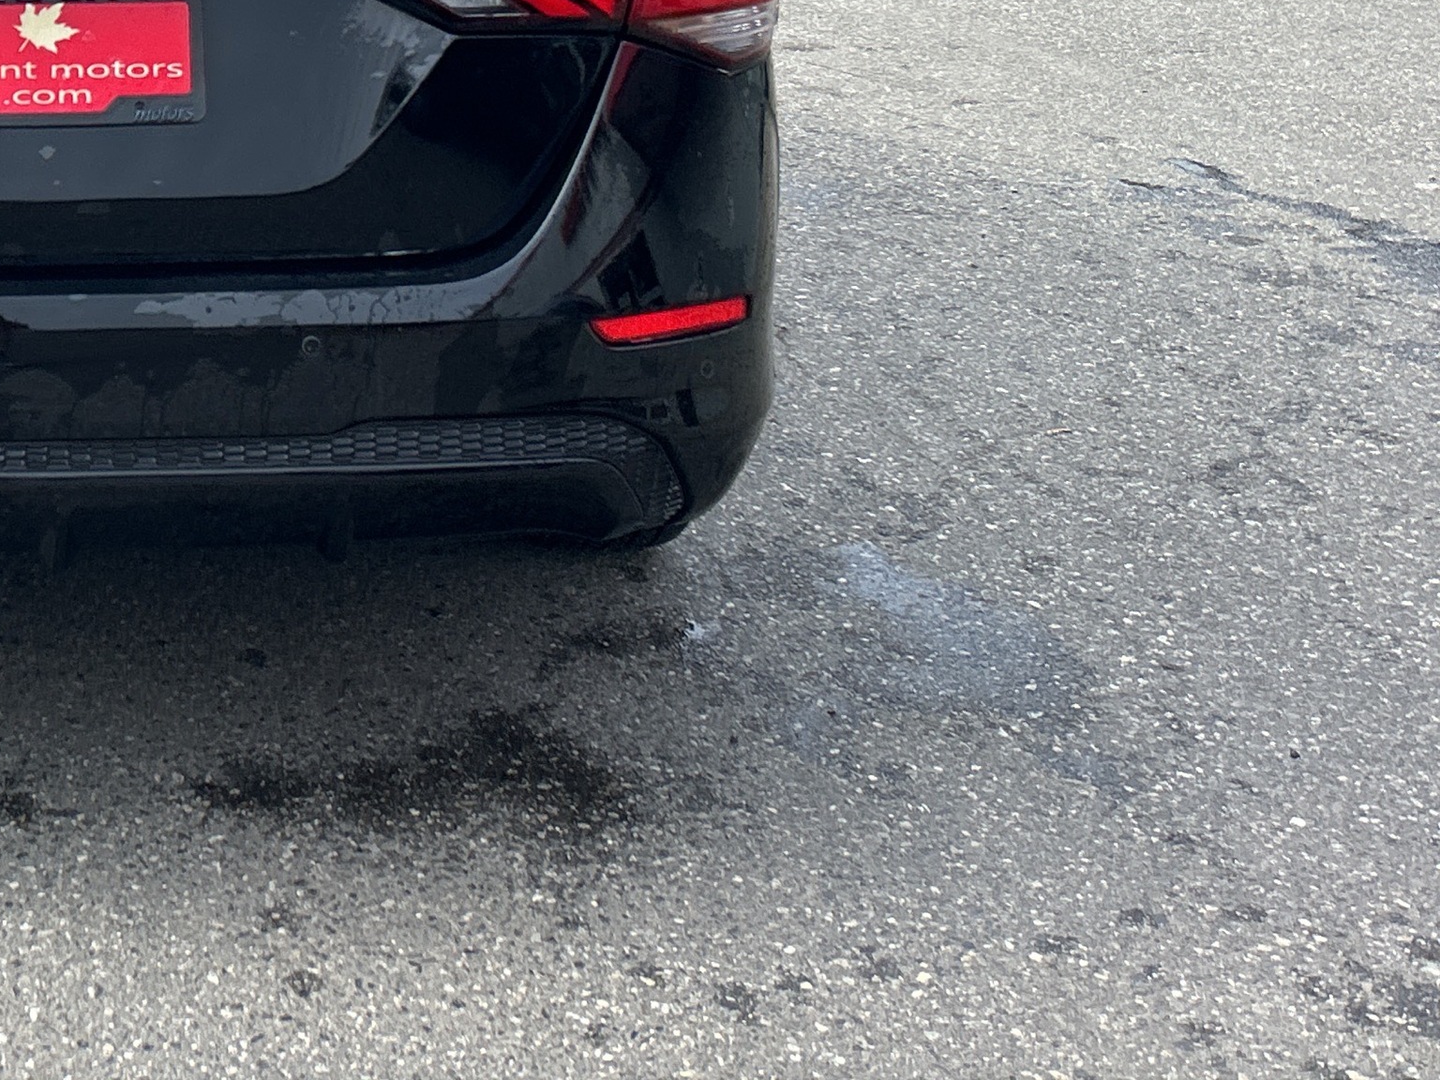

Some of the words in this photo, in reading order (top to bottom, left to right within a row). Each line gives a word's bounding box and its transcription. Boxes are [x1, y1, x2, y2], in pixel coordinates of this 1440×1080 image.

[50, 59, 183, 80] motors
[2, 87, 93, 106] .com
[134, 106, 195, 121] motors
